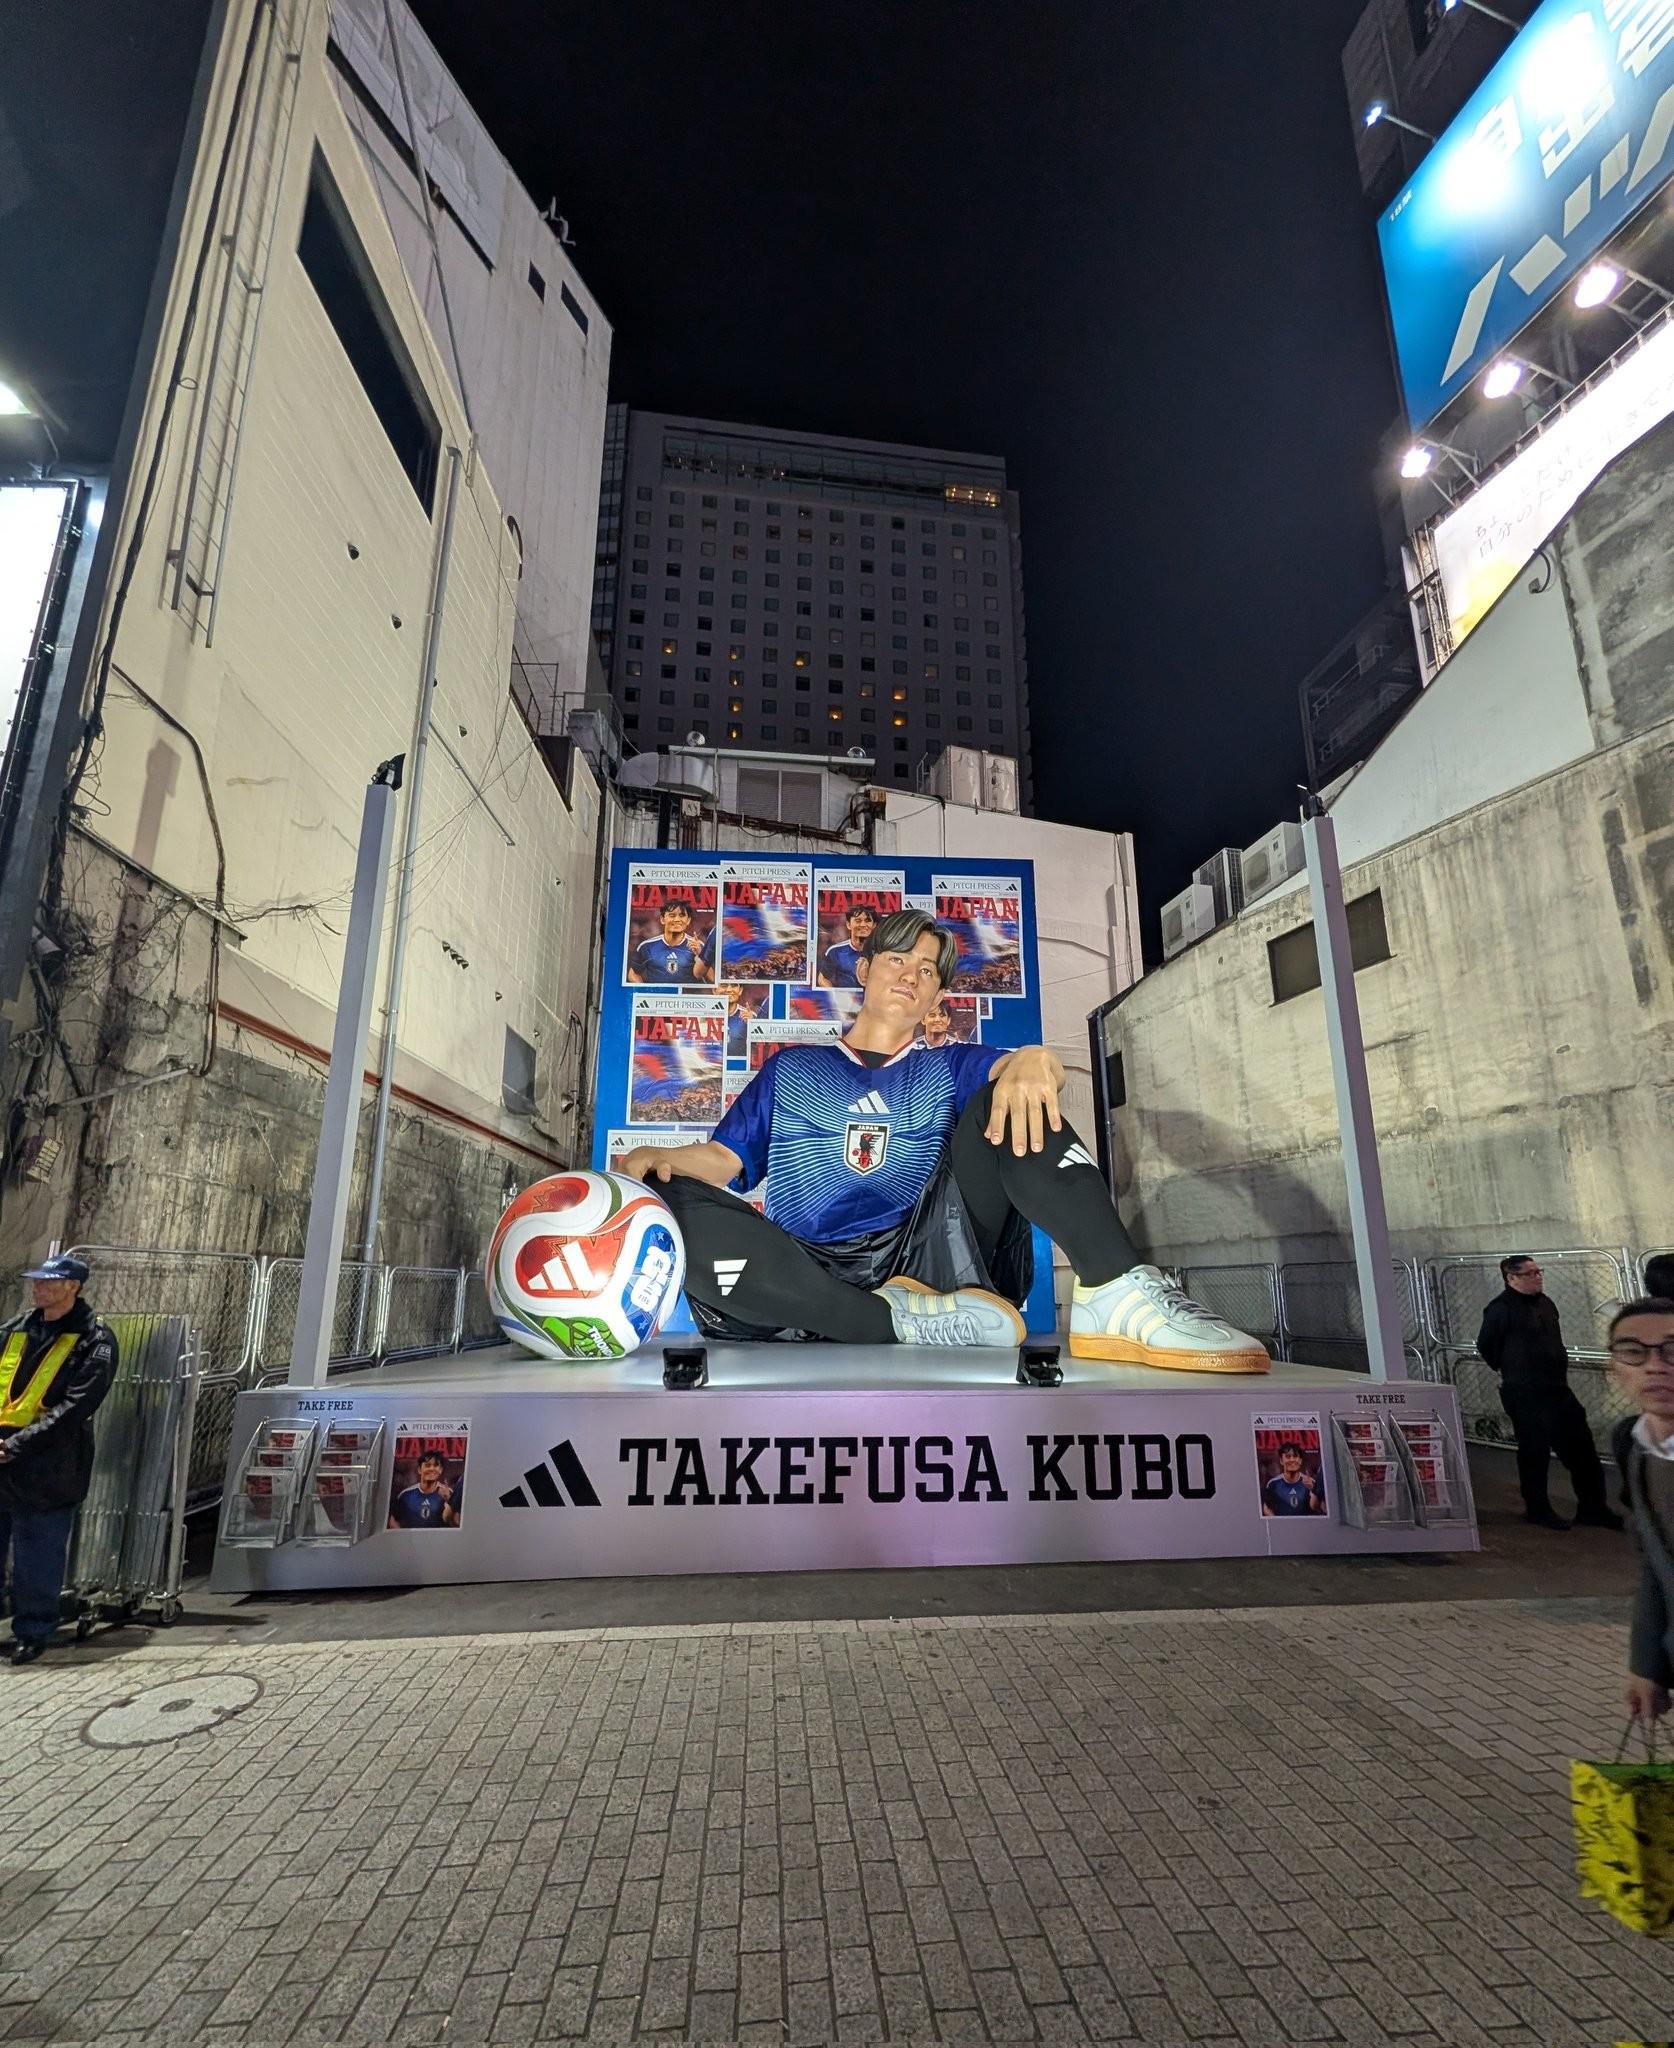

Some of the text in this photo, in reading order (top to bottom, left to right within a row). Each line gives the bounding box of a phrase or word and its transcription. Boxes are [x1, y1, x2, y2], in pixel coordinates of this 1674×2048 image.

[742, 867, 791, 876] PITCH PRESS
[860, 876, 884, 884] PRESS
[953, 882, 976, 890] PITCH
[632, 884, 718, 909] JAPAN
[723, 882, 808, 905] JAPAN
[818, 890, 902, 913] JAPAN
[936, 896, 1018, 919] JAPAN
[655, 1000, 707, 1009] PITCH PRESS
[636, 1016, 724, 1041] JAPAN
[769, 1026, 820, 1035] PITCH PRESS
[631, 1137, 683, 1146] PITCH PRESS
[855, 1157, 874, 1166] JFA
[1356, 1394, 1406, 1404] TAKE FREE
[298, 1400, 354, 1411] TAKE FREE
[1257, 1430, 1319, 1451] JAPAN
[396, 1437, 467, 1458] JAPAN
[618, 1433, 1217, 1507] TAKEFUSA KUBO
